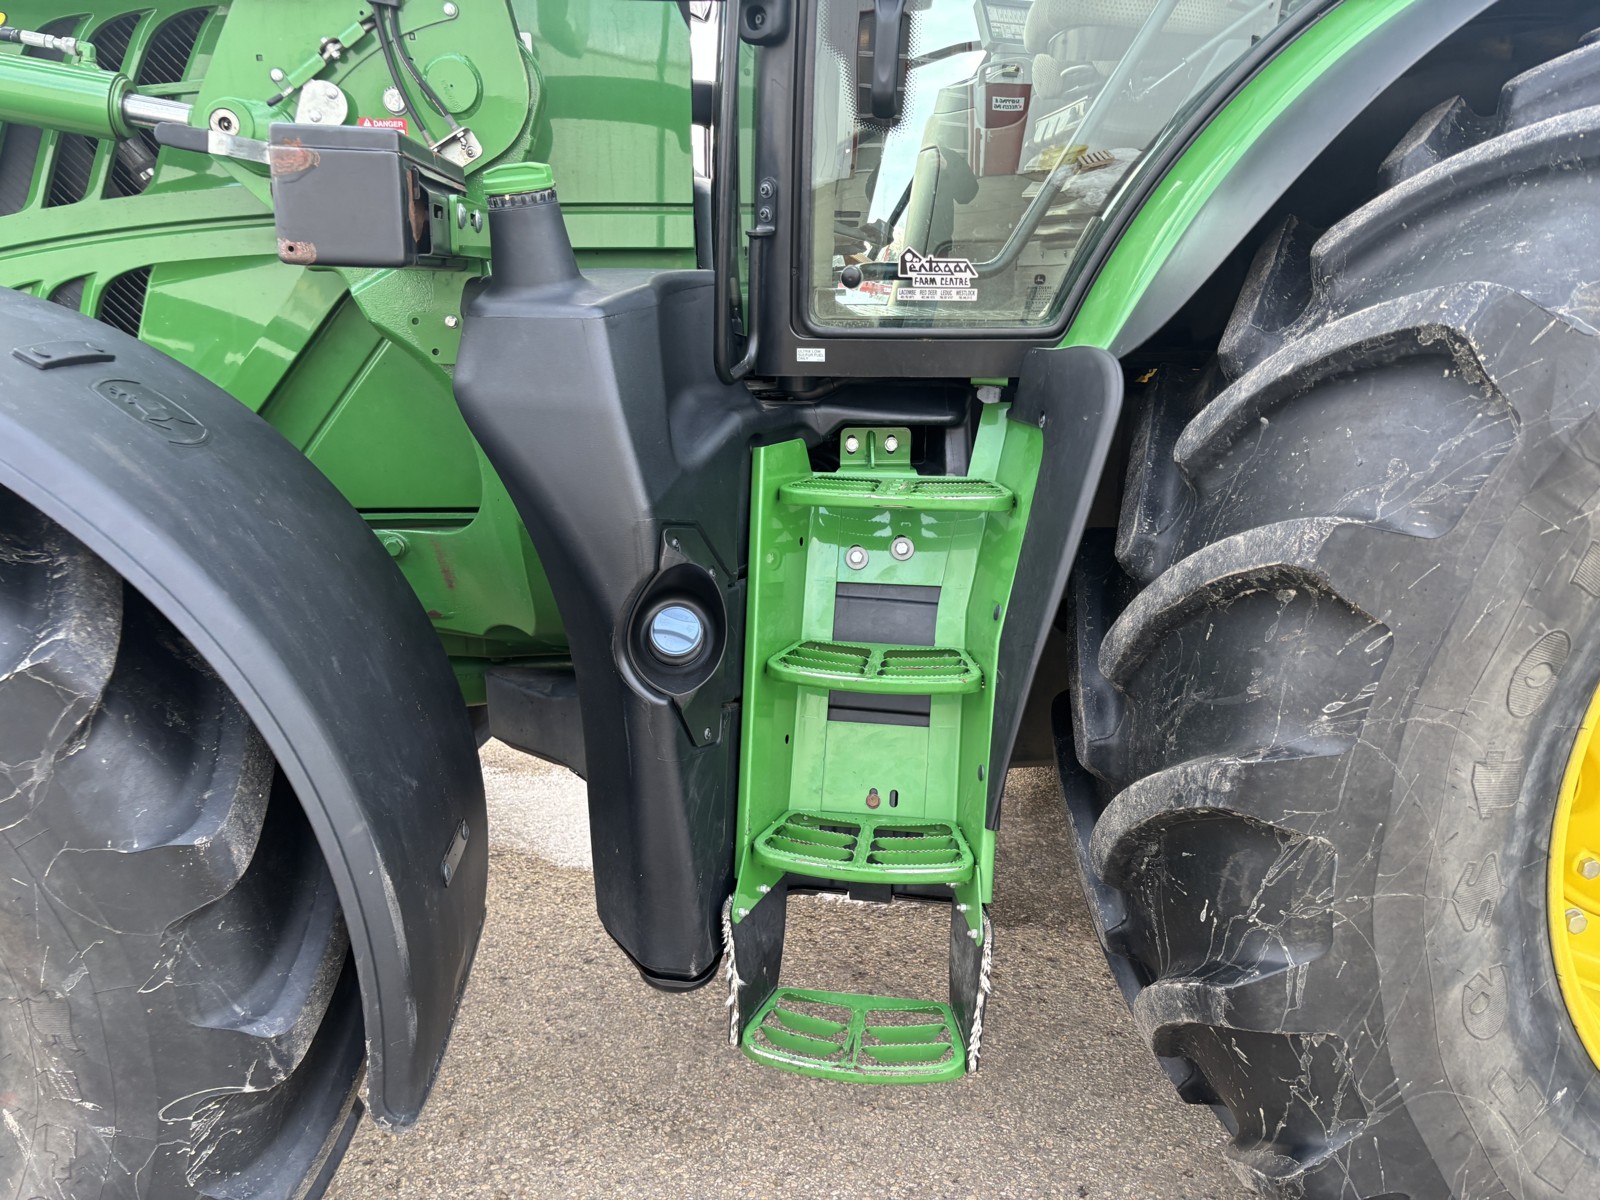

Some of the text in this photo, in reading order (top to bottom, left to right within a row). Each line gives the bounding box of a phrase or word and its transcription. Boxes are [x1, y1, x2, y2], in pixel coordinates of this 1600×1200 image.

[373, 120, 404, 128] DANGER
[900, 248, 976, 276] Pentagon
[914, 277, 969, 286] FARM CENTRE
